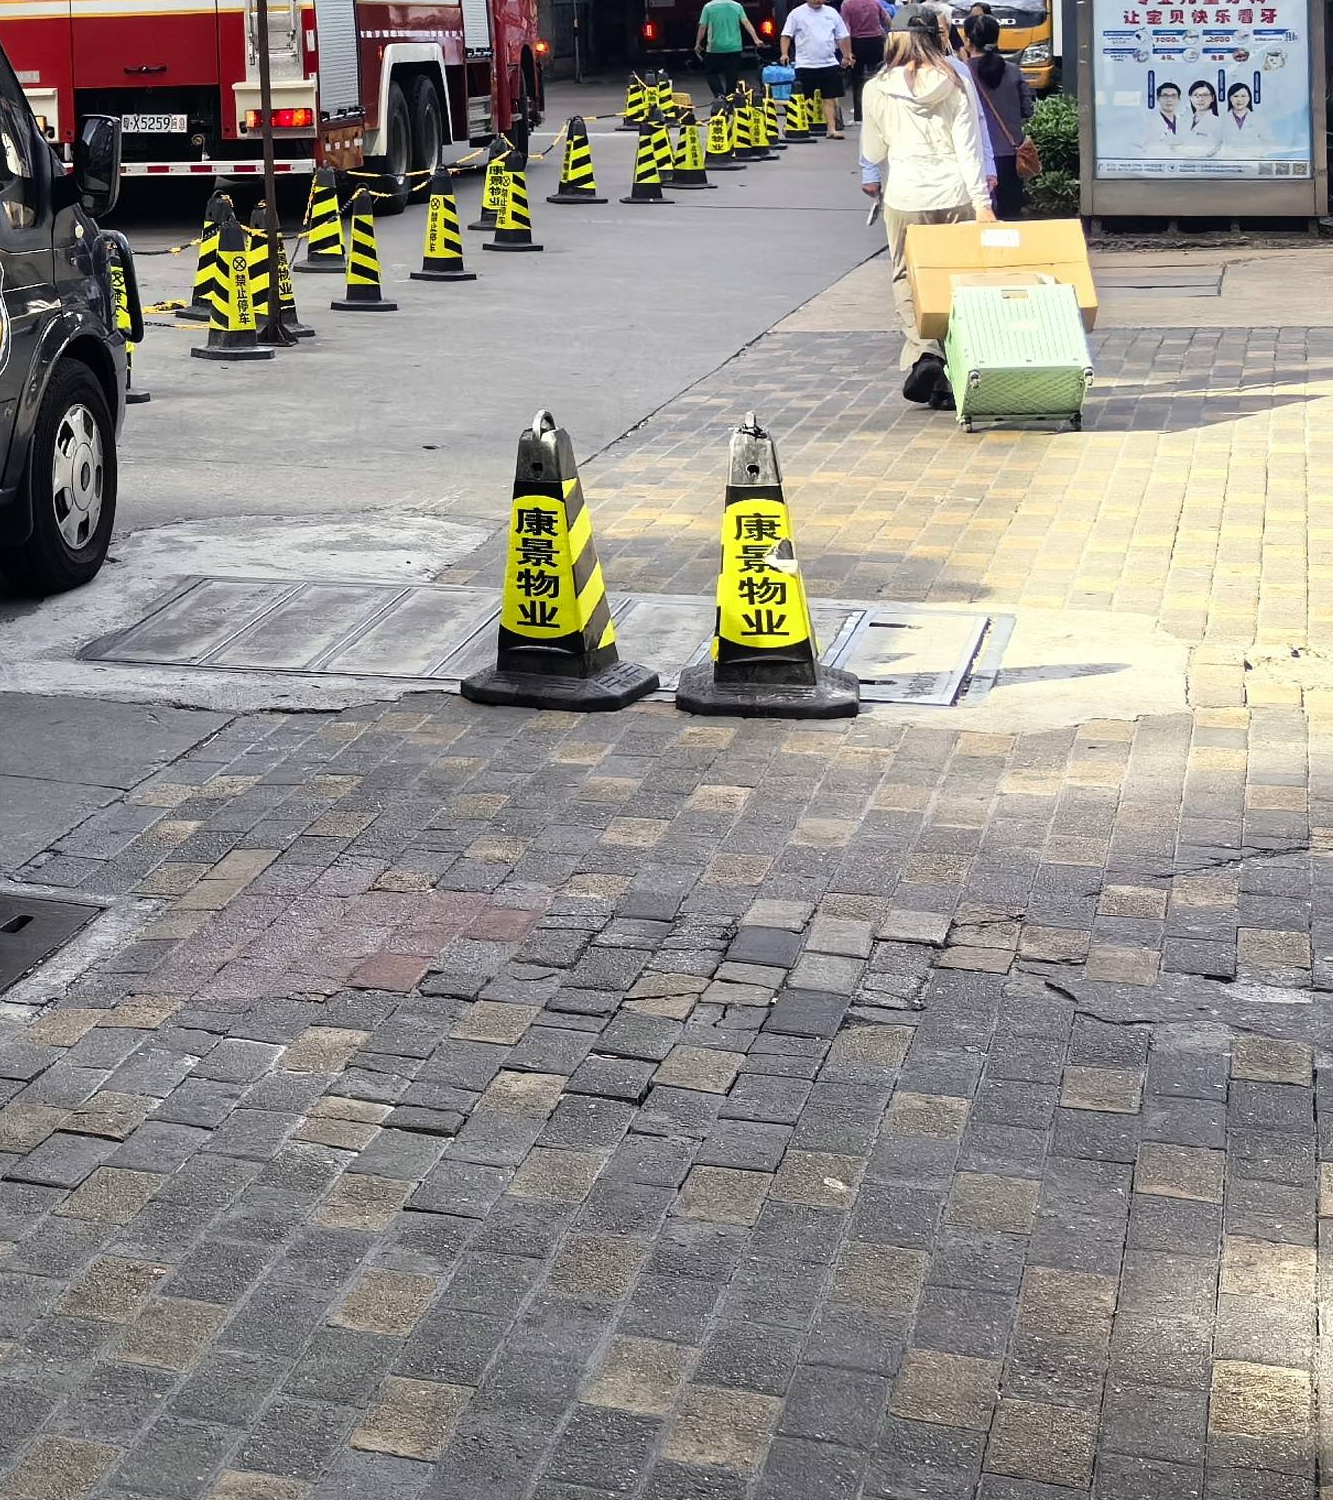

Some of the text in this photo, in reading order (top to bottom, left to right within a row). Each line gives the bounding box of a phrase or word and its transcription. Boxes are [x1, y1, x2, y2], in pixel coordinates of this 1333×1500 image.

[1123, 8, 1278, 25] 让宝贝快乐看牙
[515, 507, 561, 629] 康景物业
[734, 513, 790, 637] 康景物业
